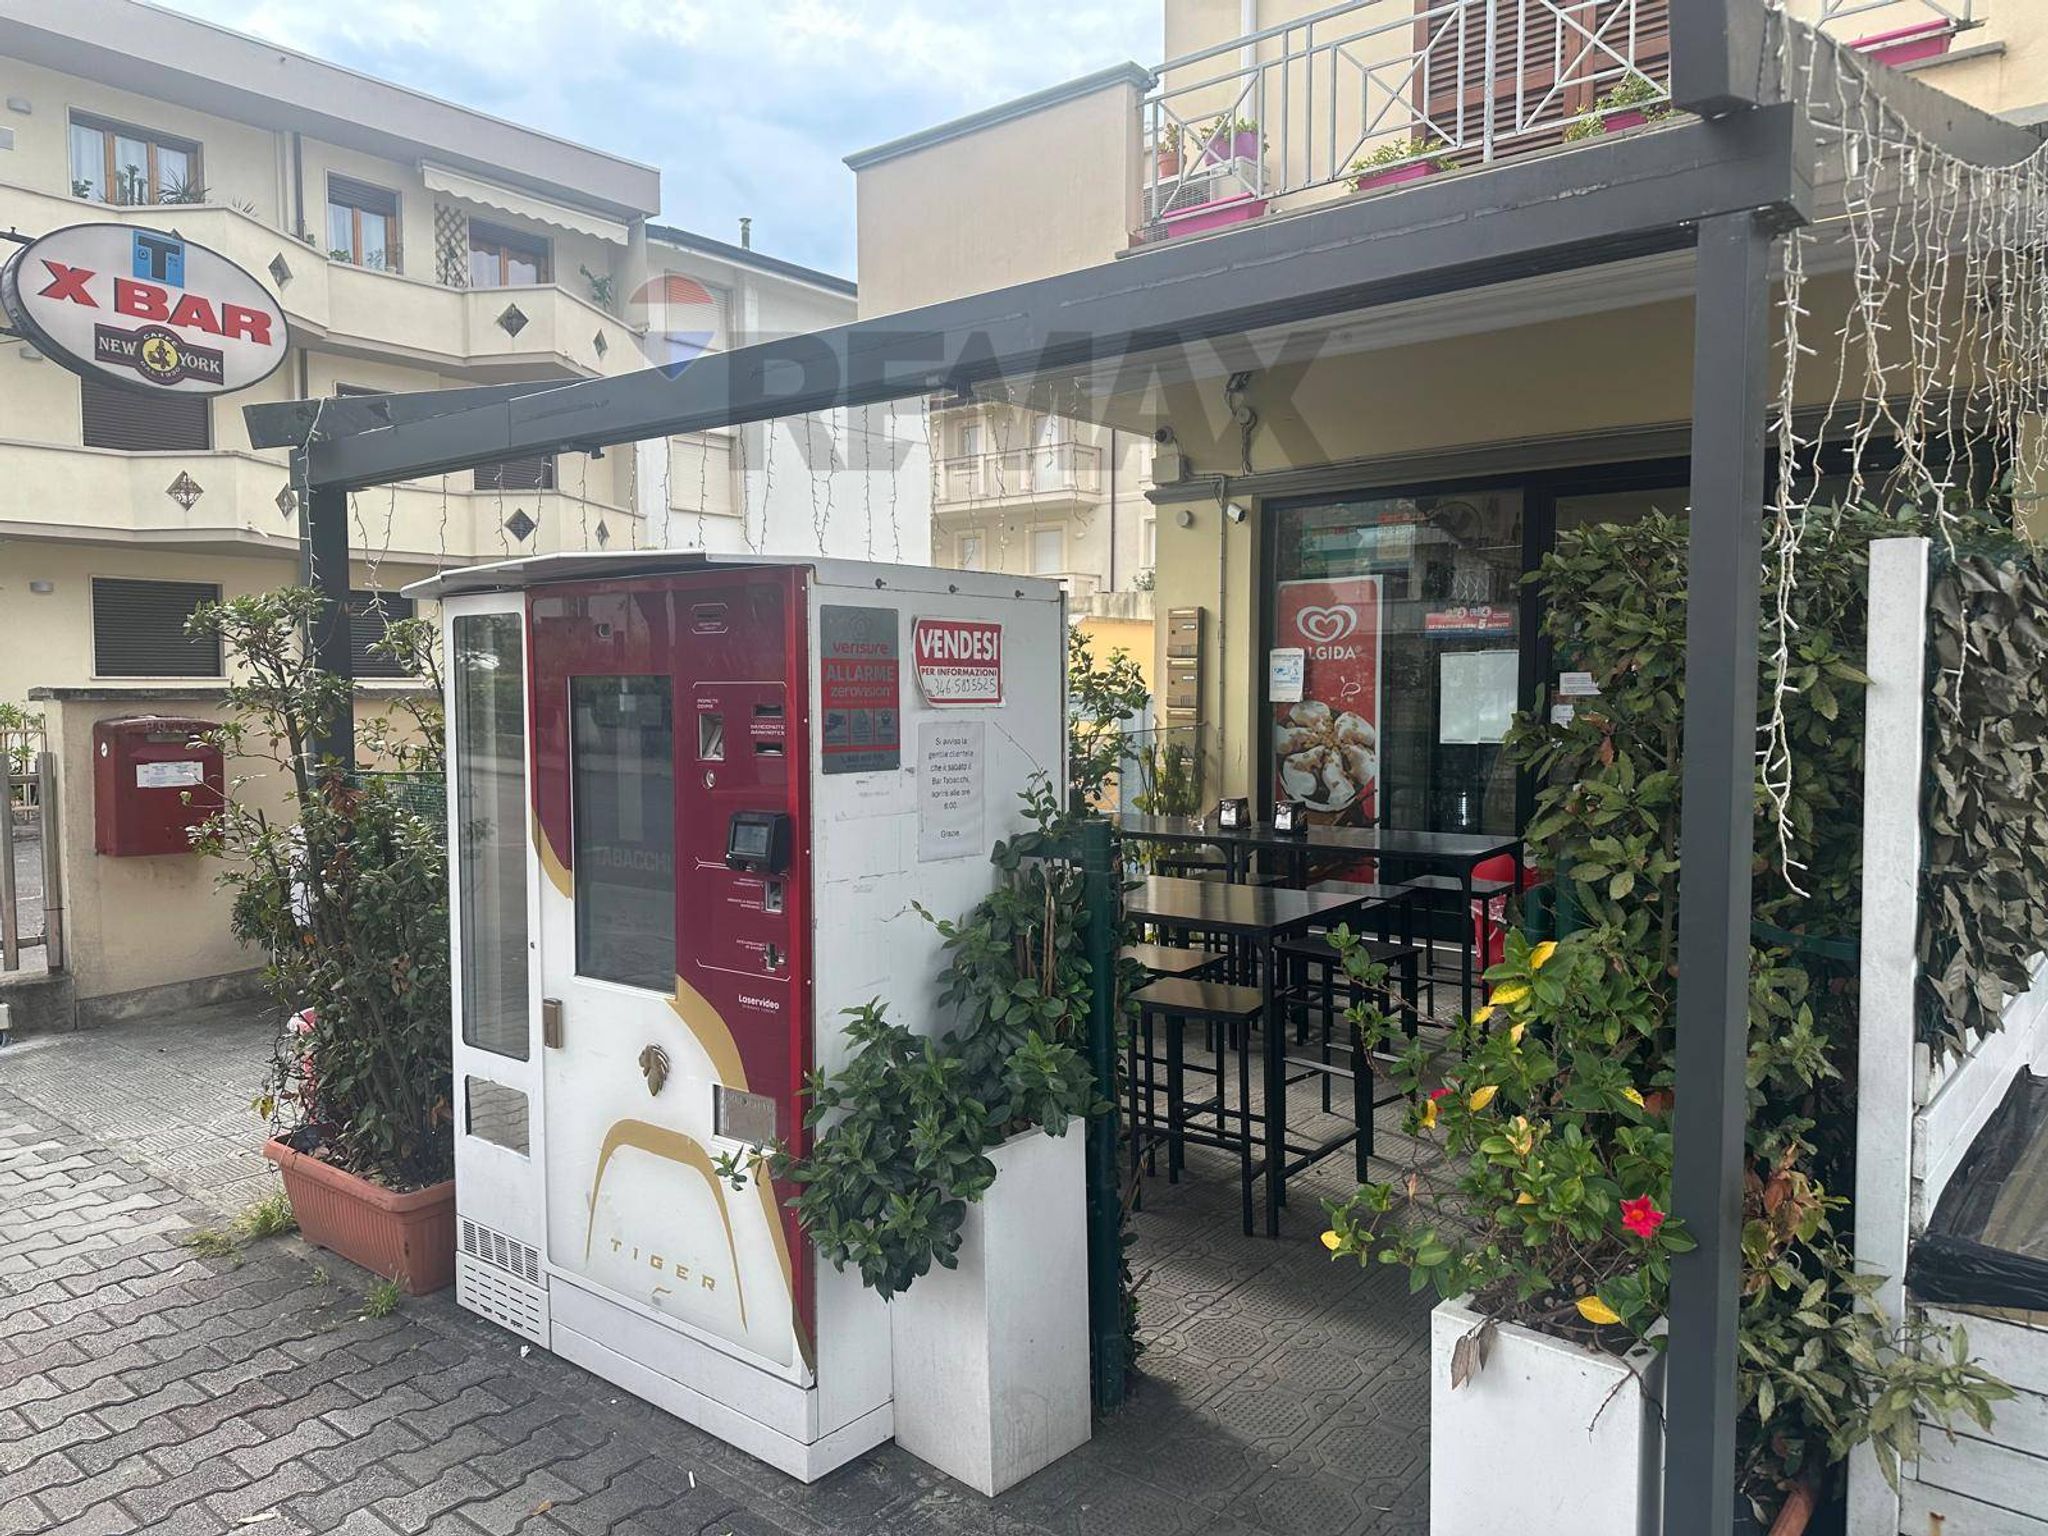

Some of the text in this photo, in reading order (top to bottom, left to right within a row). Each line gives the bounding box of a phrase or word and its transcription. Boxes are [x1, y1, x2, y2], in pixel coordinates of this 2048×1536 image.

[37, 259, 272, 346] X BAR
[99, 336, 222, 374] NEW YORK
[1478, 618, 1487, 630] 5
[831, 642, 890, 655] verisure
[919, 628, 998, 660] VENDESI
[1307, 646, 1357, 660] LGIDA
[826, 664, 896, 681] ALLARME
[920, 667, 997, 677] PER INFORMAZIONI
[738, 993, 780, 1010] Laservideo
[610, 1238, 716, 1292] TIGER
